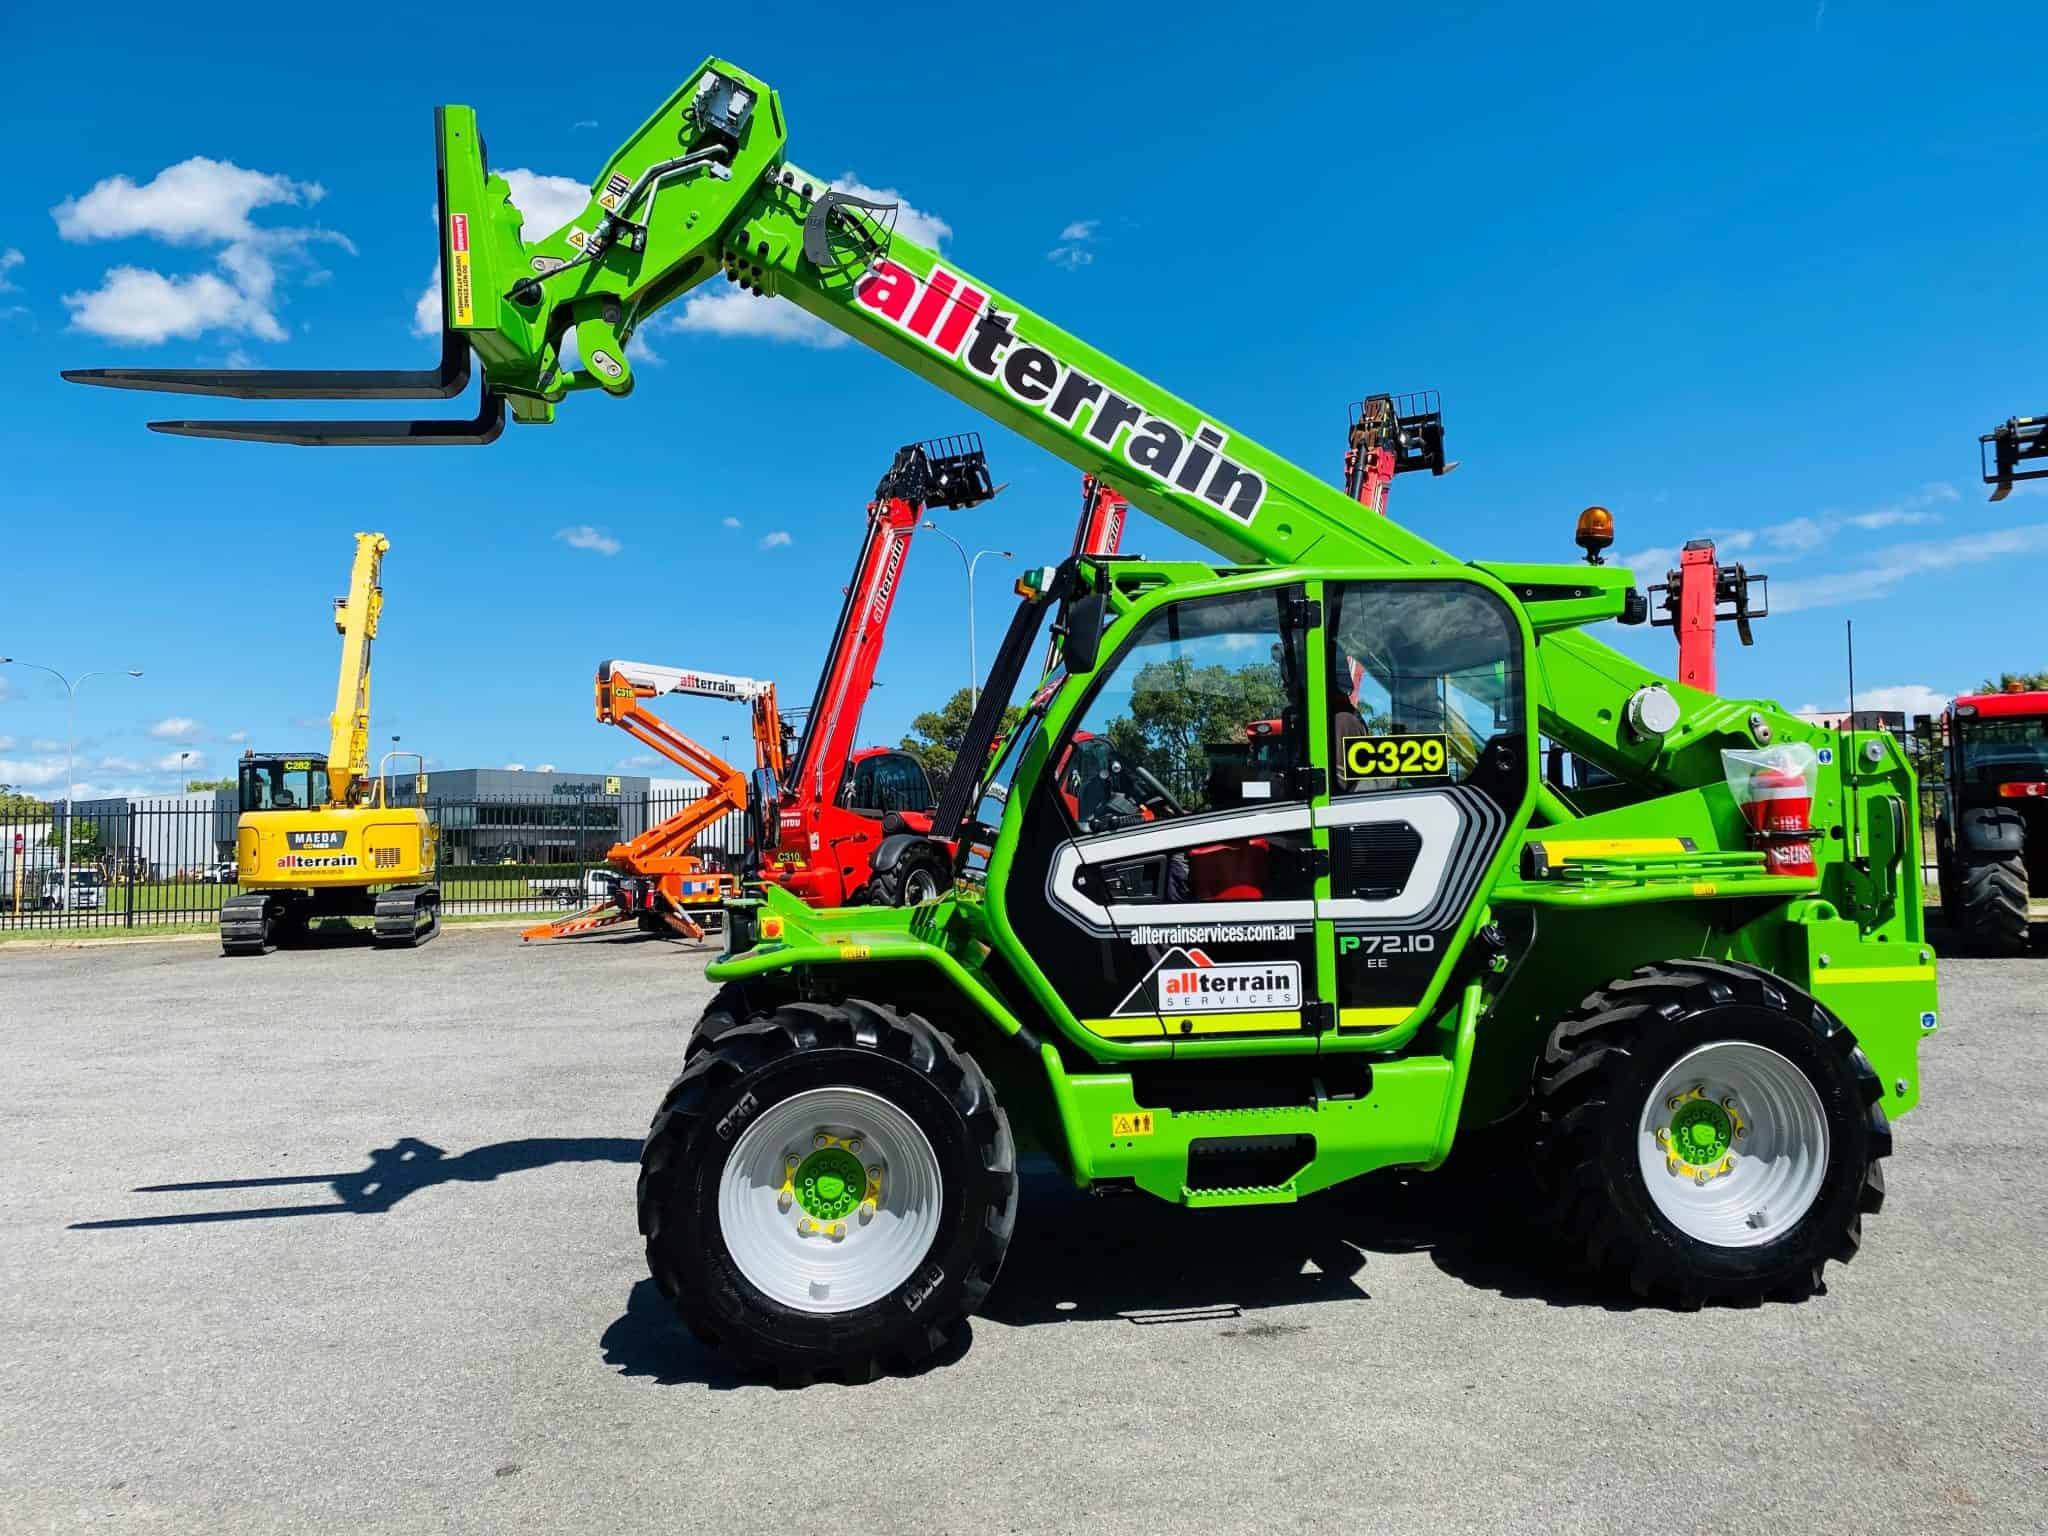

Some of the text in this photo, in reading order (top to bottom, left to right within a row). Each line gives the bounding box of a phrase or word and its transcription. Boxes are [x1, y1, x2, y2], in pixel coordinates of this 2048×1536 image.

[855, 261, 1266, 523] allterrain
[874, 539, 904, 622] allterrain
[680, 674, 736, 694] allterrain
[1347, 739, 1445, 775] C329
[295, 832, 337, 844] MAEDA
[276, 854, 357, 868] allterrain
[777, 852, 800, 863] C310
[1130, 925, 1295, 945] allterrainservices.com.au
[1340, 934, 1435, 955] P72.10
[1367, 959, 1388, 968] EE
[1165, 968, 1290, 994] allterrain
[1167, 993, 1291, 1007] SERVICES
[716, 1091, 758, 1140] BKT
